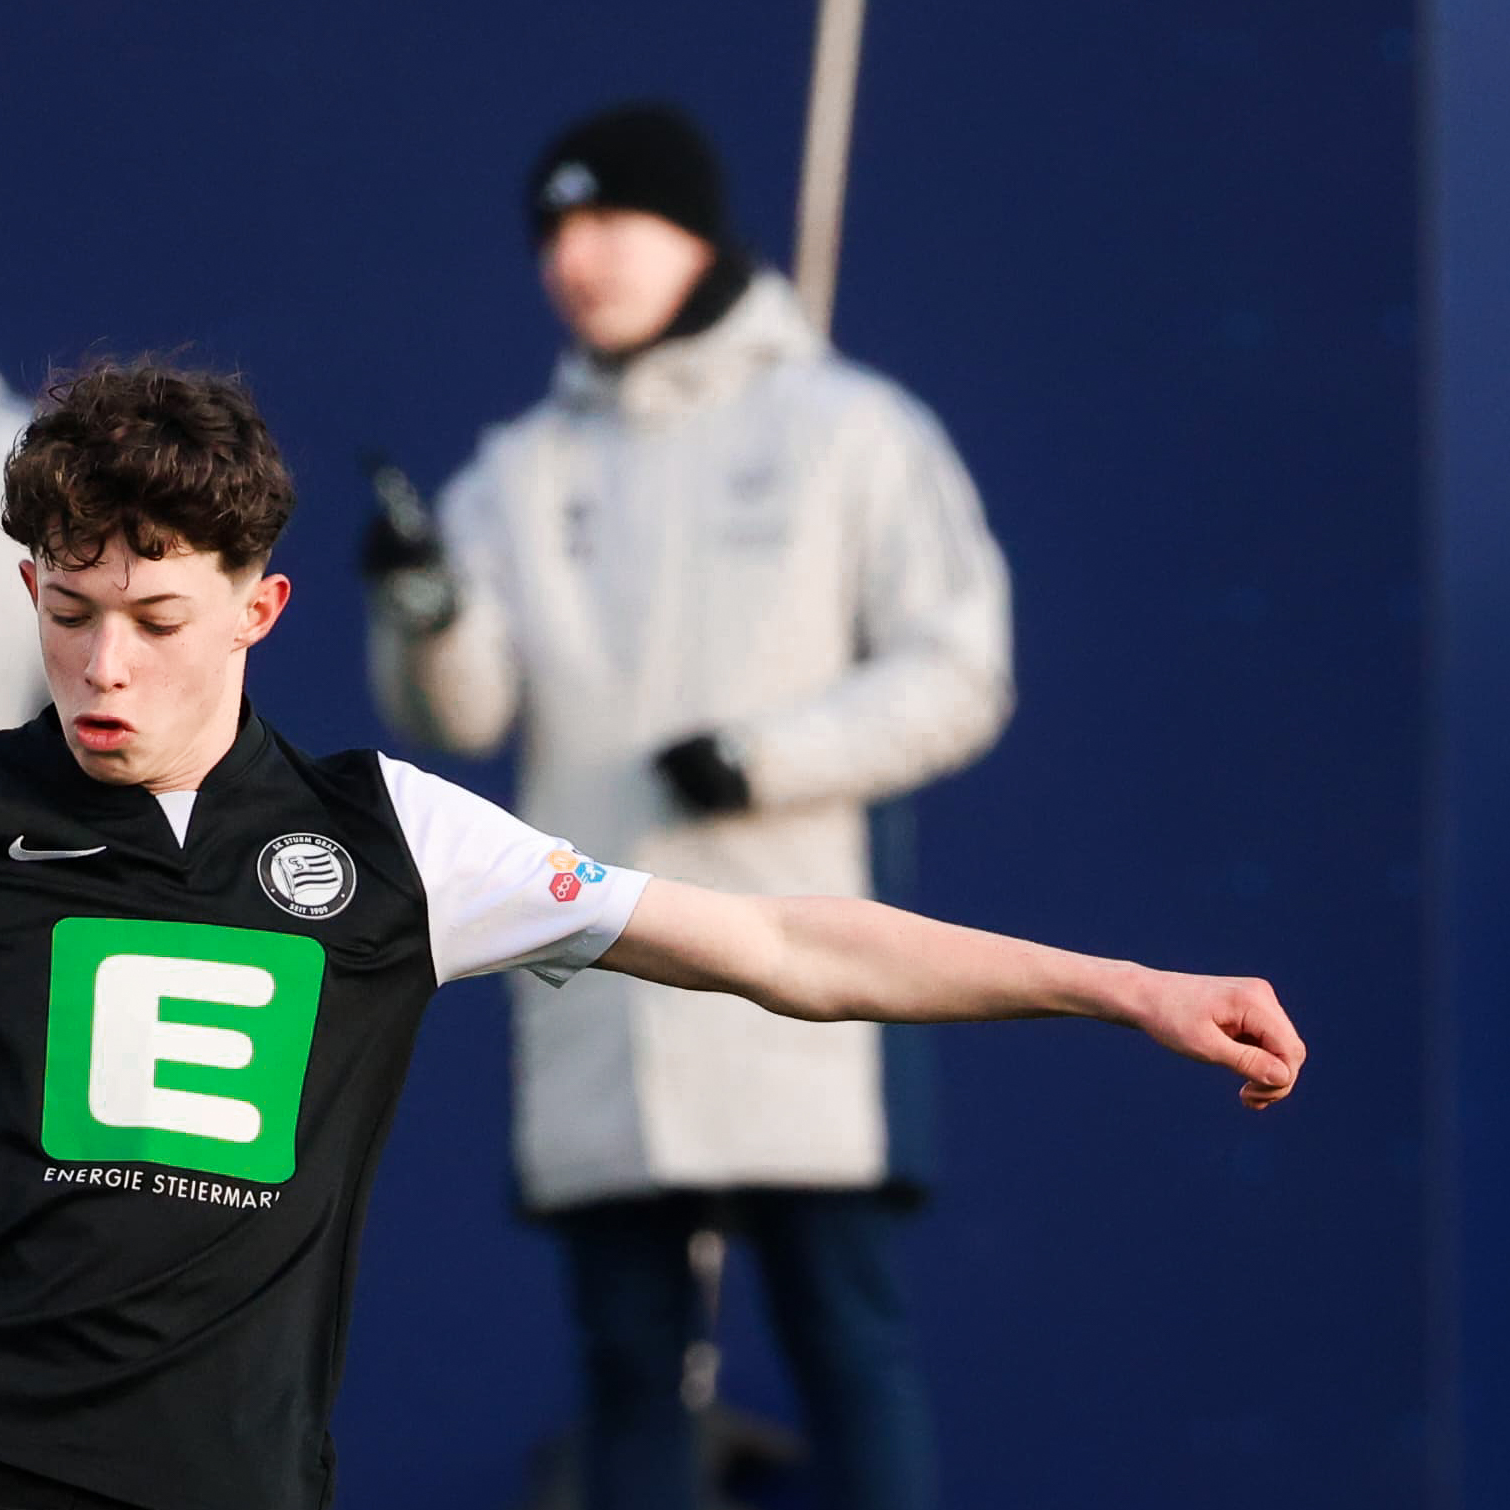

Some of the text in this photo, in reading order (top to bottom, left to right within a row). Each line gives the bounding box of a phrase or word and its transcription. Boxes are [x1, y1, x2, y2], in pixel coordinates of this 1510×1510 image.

[284, 836, 312, 846] STURM
[314, 838, 339, 853] GRAZ
[289, 903, 329, 915] SEIT 1909
[88, 953, 275, 1144] E
[43, 1166, 282, 1210] ENERGIE STEIERMAR
